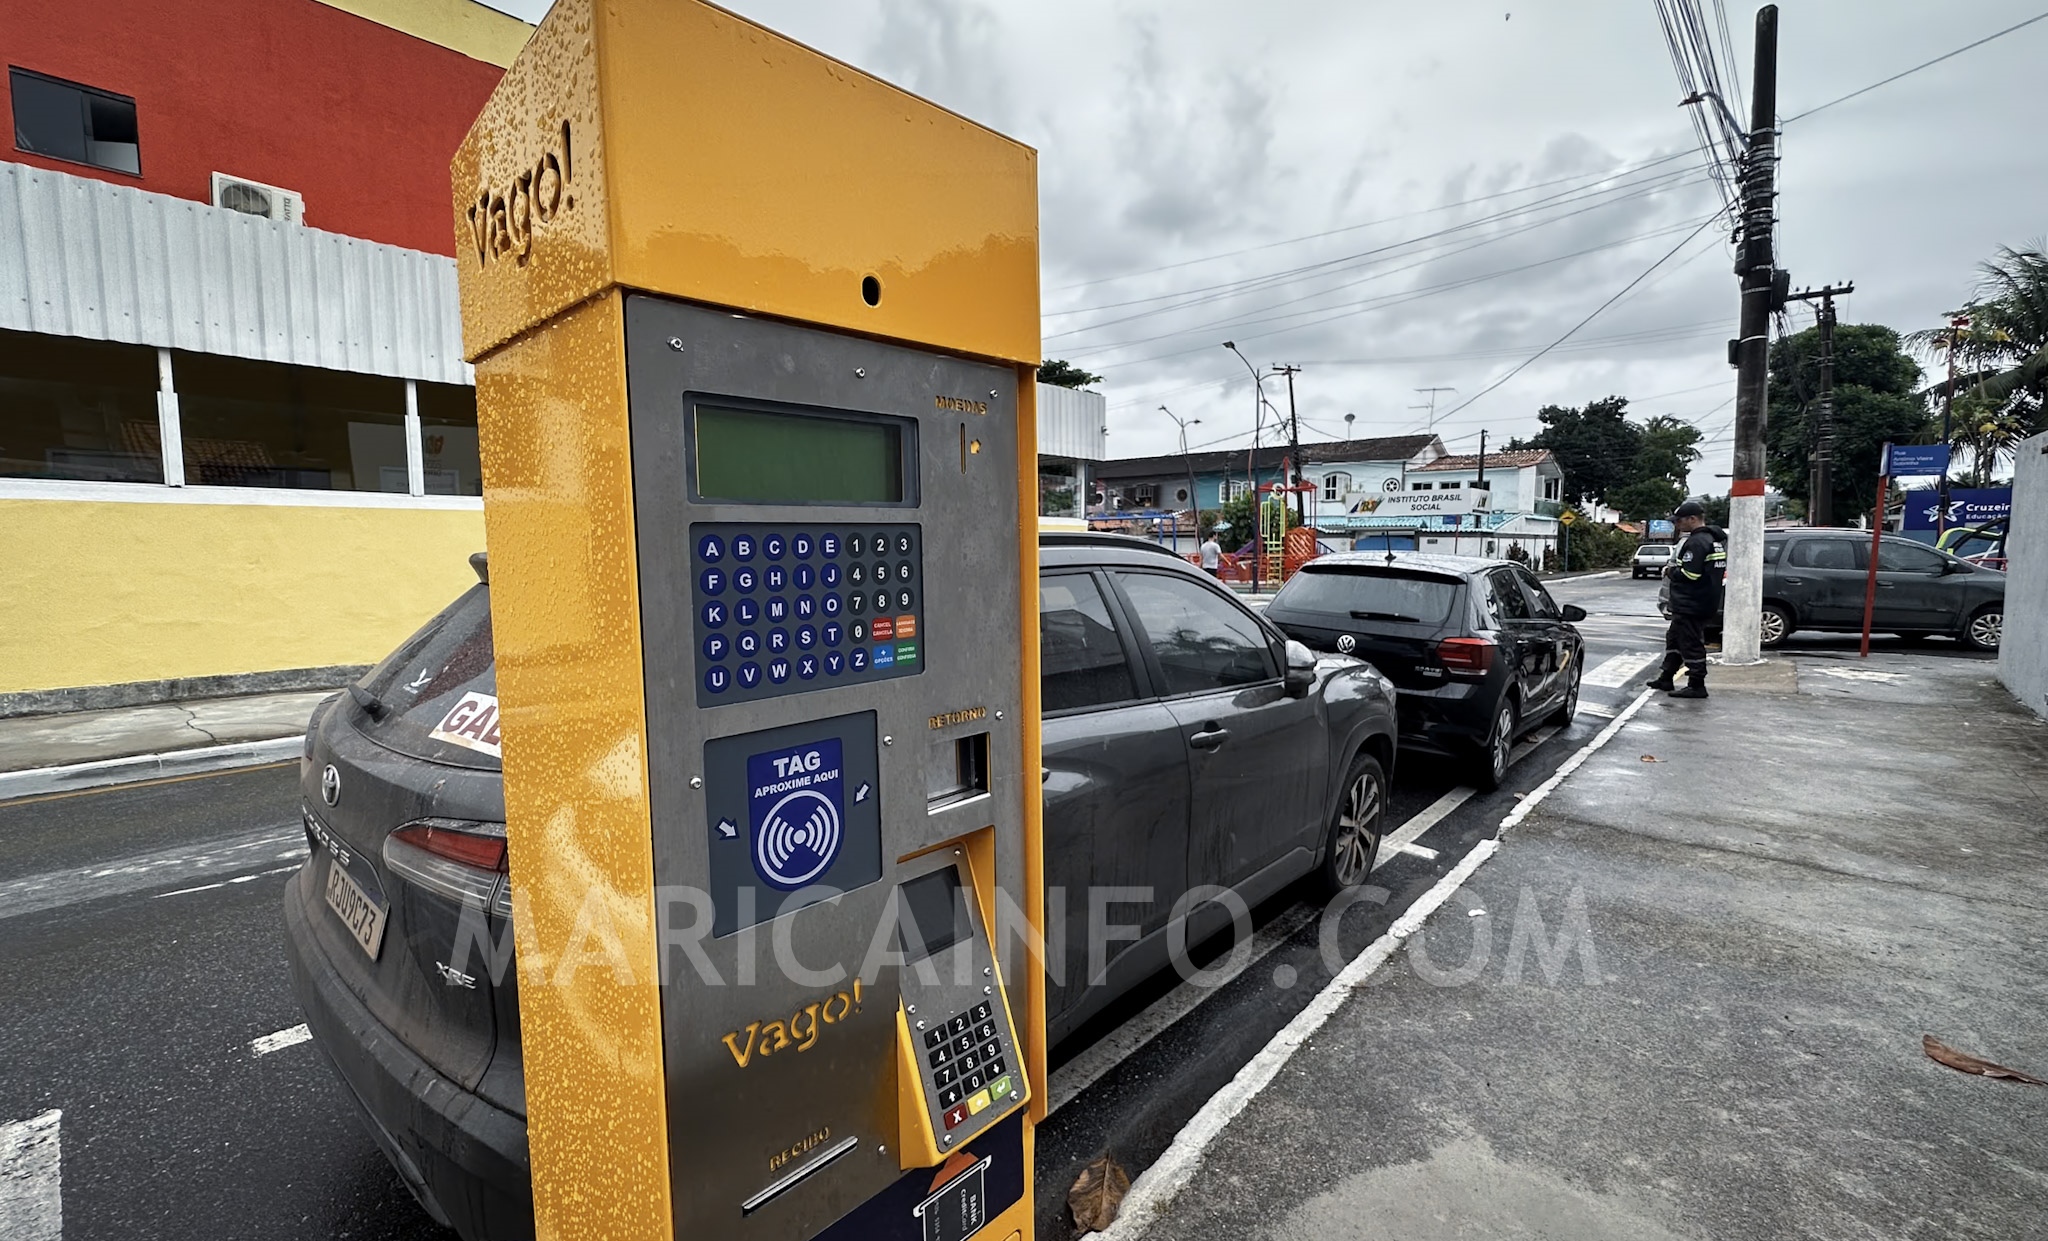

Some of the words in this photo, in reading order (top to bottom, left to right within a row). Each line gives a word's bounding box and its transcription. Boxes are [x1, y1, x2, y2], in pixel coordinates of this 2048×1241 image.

[467, 119, 574, 271] Vago!
[935, 396, 987, 416] MOEDAS
[1387, 495, 1430, 503] INSTITUTO
[1432, 494, 1463, 502] BRASIL
[1411, 503, 1441, 511] SOCIAL
[1966, 503, 2010, 511] Cruzeir
[706, 542, 719, 556] A
[739, 541, 750, 556] B
[769, 541, 780, 555] C
[798, 541, 808, 554] D
[825, 540, 835, 553] E
[853, 540, 859, 552] 1
[877, 539, 885, 551] 2
[900, 538, 908, 550] 3
[708, 575, 719, 590] F
[739, 573, 752, 588] G
[770, 572, 781, 586] H
[802, 571, 806, 584] I
[827, 569, 836, 583] J
[853, 569, 861, 580] 4
[877, 567, 885, 580] 5
[901, 566, 908, 578] 6
[708, 608, 721, 623] K
[742, 606, 752, 619] L
[771, 603, 783, 617] M
[800, 601, 811, 615] N
[826, 599, 838, 612] O
[853, 597, 861, 609] 7
[878, 595, 886, 608] 8
[901, 593, 909, 606] 9
[711, 640, 722, 655] P
[741, 637, 755, 651] Q
[772, 634, 784, 648] R
[801, 631, 811, 644] S
[827, 628, 837, 641] T
[854, 625, 862, 638] 0
[712, 672, 724, 687] U
[744, 668, 755, 682] V
[771, 664, 787, 679] W
[803, 660, 813, 675] X
[829, 657, 839, 670] Y
[855, 653, 864, 667] Z
[928, 706, 987, 729] RETORNO
[773, 751, 820, 778] TAG
[754, 776, 811, 798] APROXIME
[813, 769, 839, 784] AQUI
[329, 868, 376, 946] RJU9C73
[435, 961, 476, 989] XRE
[721, 976, 863, 1069] Vago!
[935, 1031, 941, 1042] 1
[956, 1018, 964, 1031] 2
[978, 1006, 986, 1018] 3
[939, 1050, 946, 1062] 4
[961, 1037, 969, 1050] 5
[983, 1025, 991, 1037] 6
[943, 1070, 949, 1083] 7
[966, 1057, 974, 1069] 8
[988, 1044, 995, 1056] 9
[971, 1076, 979, 1088] 0
[770, 1126, 831, 1171] RECIBO
